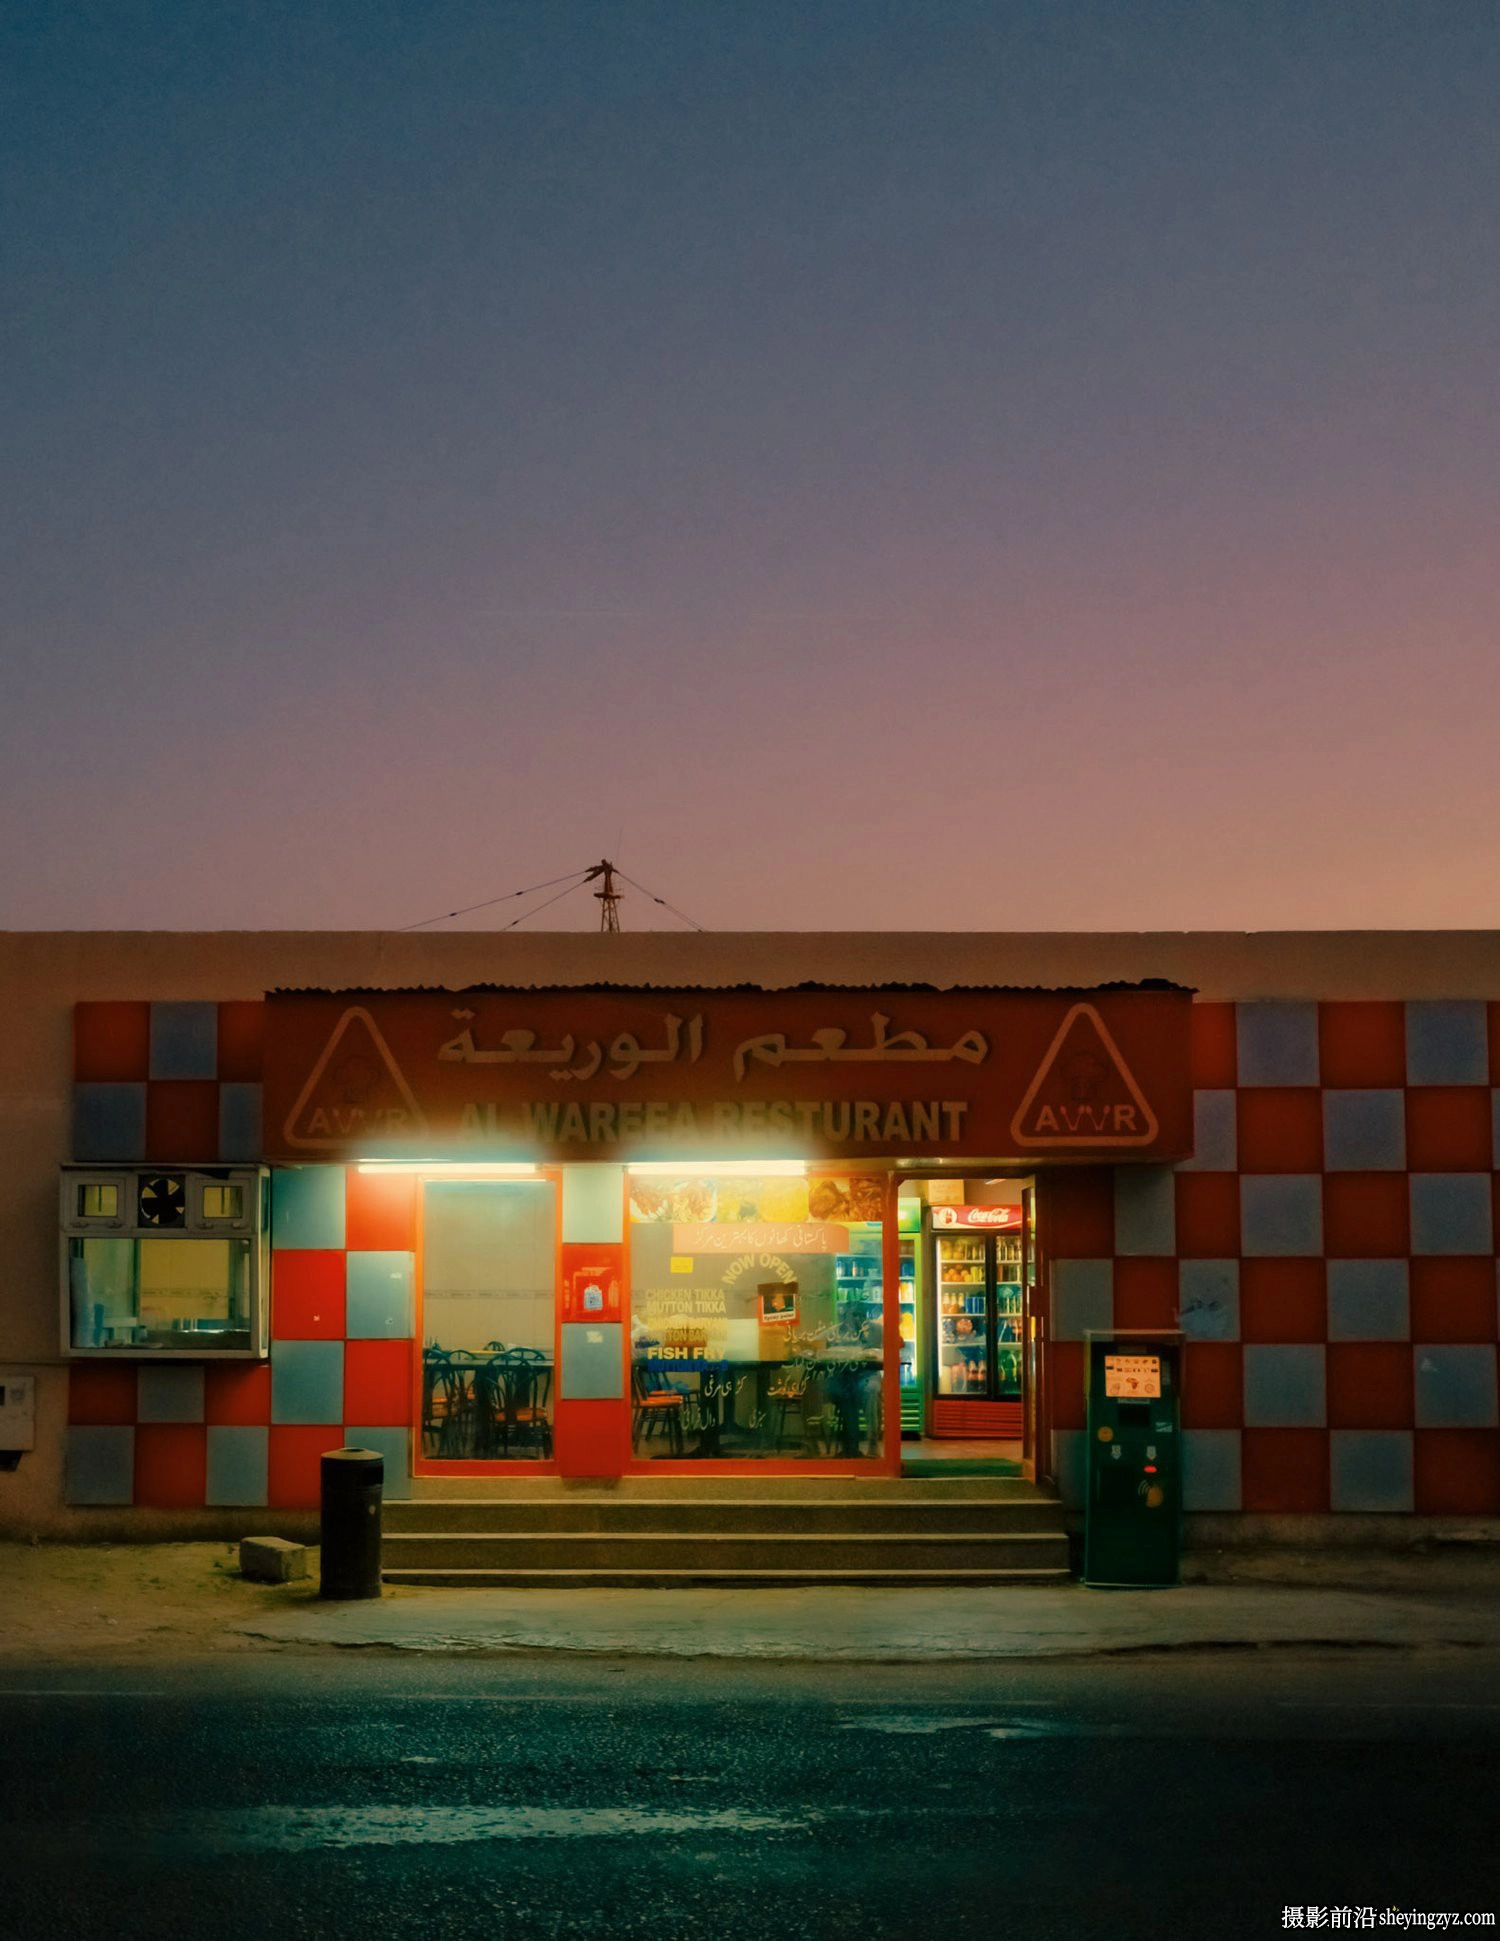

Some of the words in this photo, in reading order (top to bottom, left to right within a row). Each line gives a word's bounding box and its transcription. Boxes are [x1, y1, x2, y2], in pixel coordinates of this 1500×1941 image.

[437, 1006, 703, 1081] الوريعة
[733, 1010, 989, 1084] مطعم
[459, 1102, 502, 1141] AL
[521, 1101, 698, 1143] WAREEA
[713, 1100, 969, 1143] RESTURANT
[721, 1253, 756, 1286] NOW
[758, 1252, 799, 1285] OPEN
[646, 1300, 693, 1313] MUTTON
[696, 1300, 727, 1313] TIKKA
[695, 1288, 725, 1301] TIKKA
[646, 1346, 688, 1360] FISH
[693, 1346, 726, 1360] FRY
